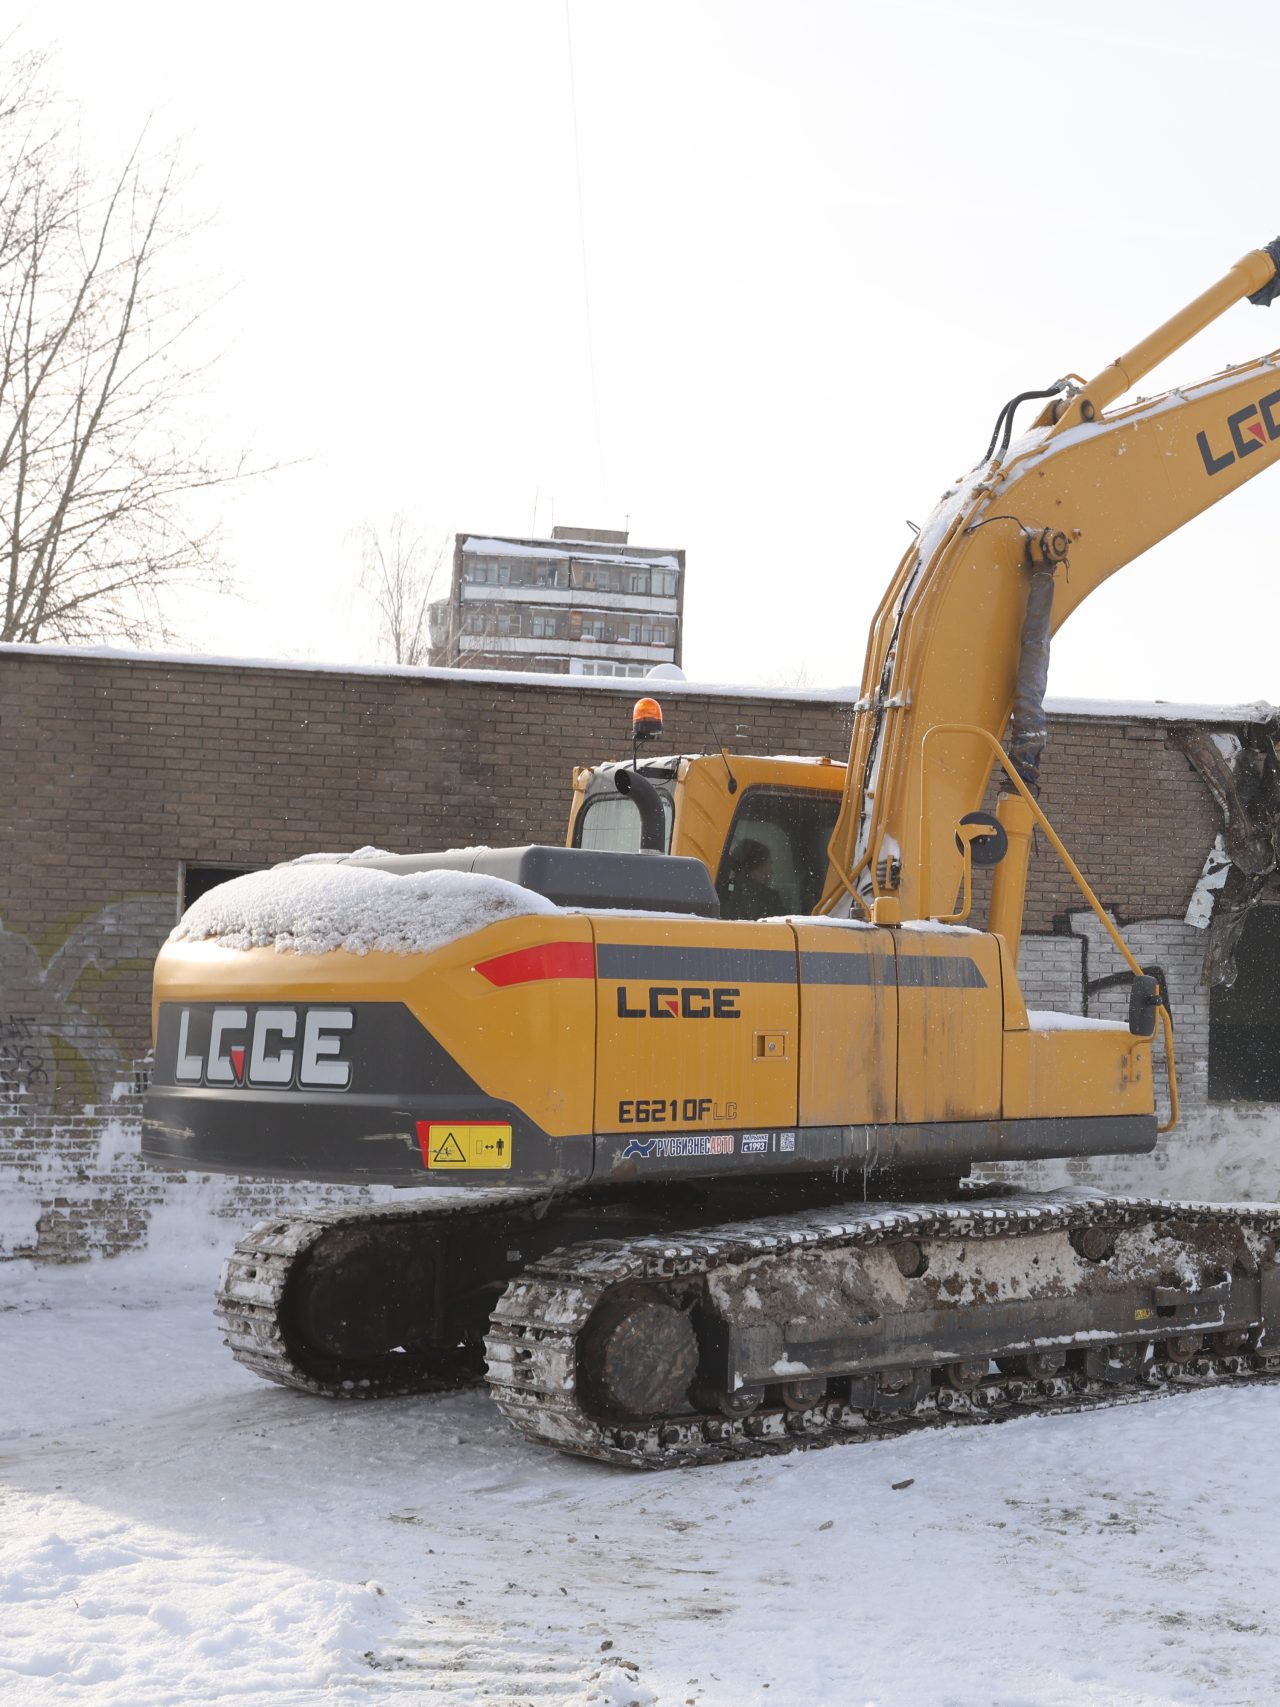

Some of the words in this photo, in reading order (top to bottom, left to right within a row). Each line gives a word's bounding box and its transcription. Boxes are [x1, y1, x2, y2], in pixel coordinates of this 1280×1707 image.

[617, 986, 741, 1018] LGCE
[175, 1008, 354, 1087] LGCE
[656, 1135, 734, 1157] РУСБИЗНЕСАВТО
